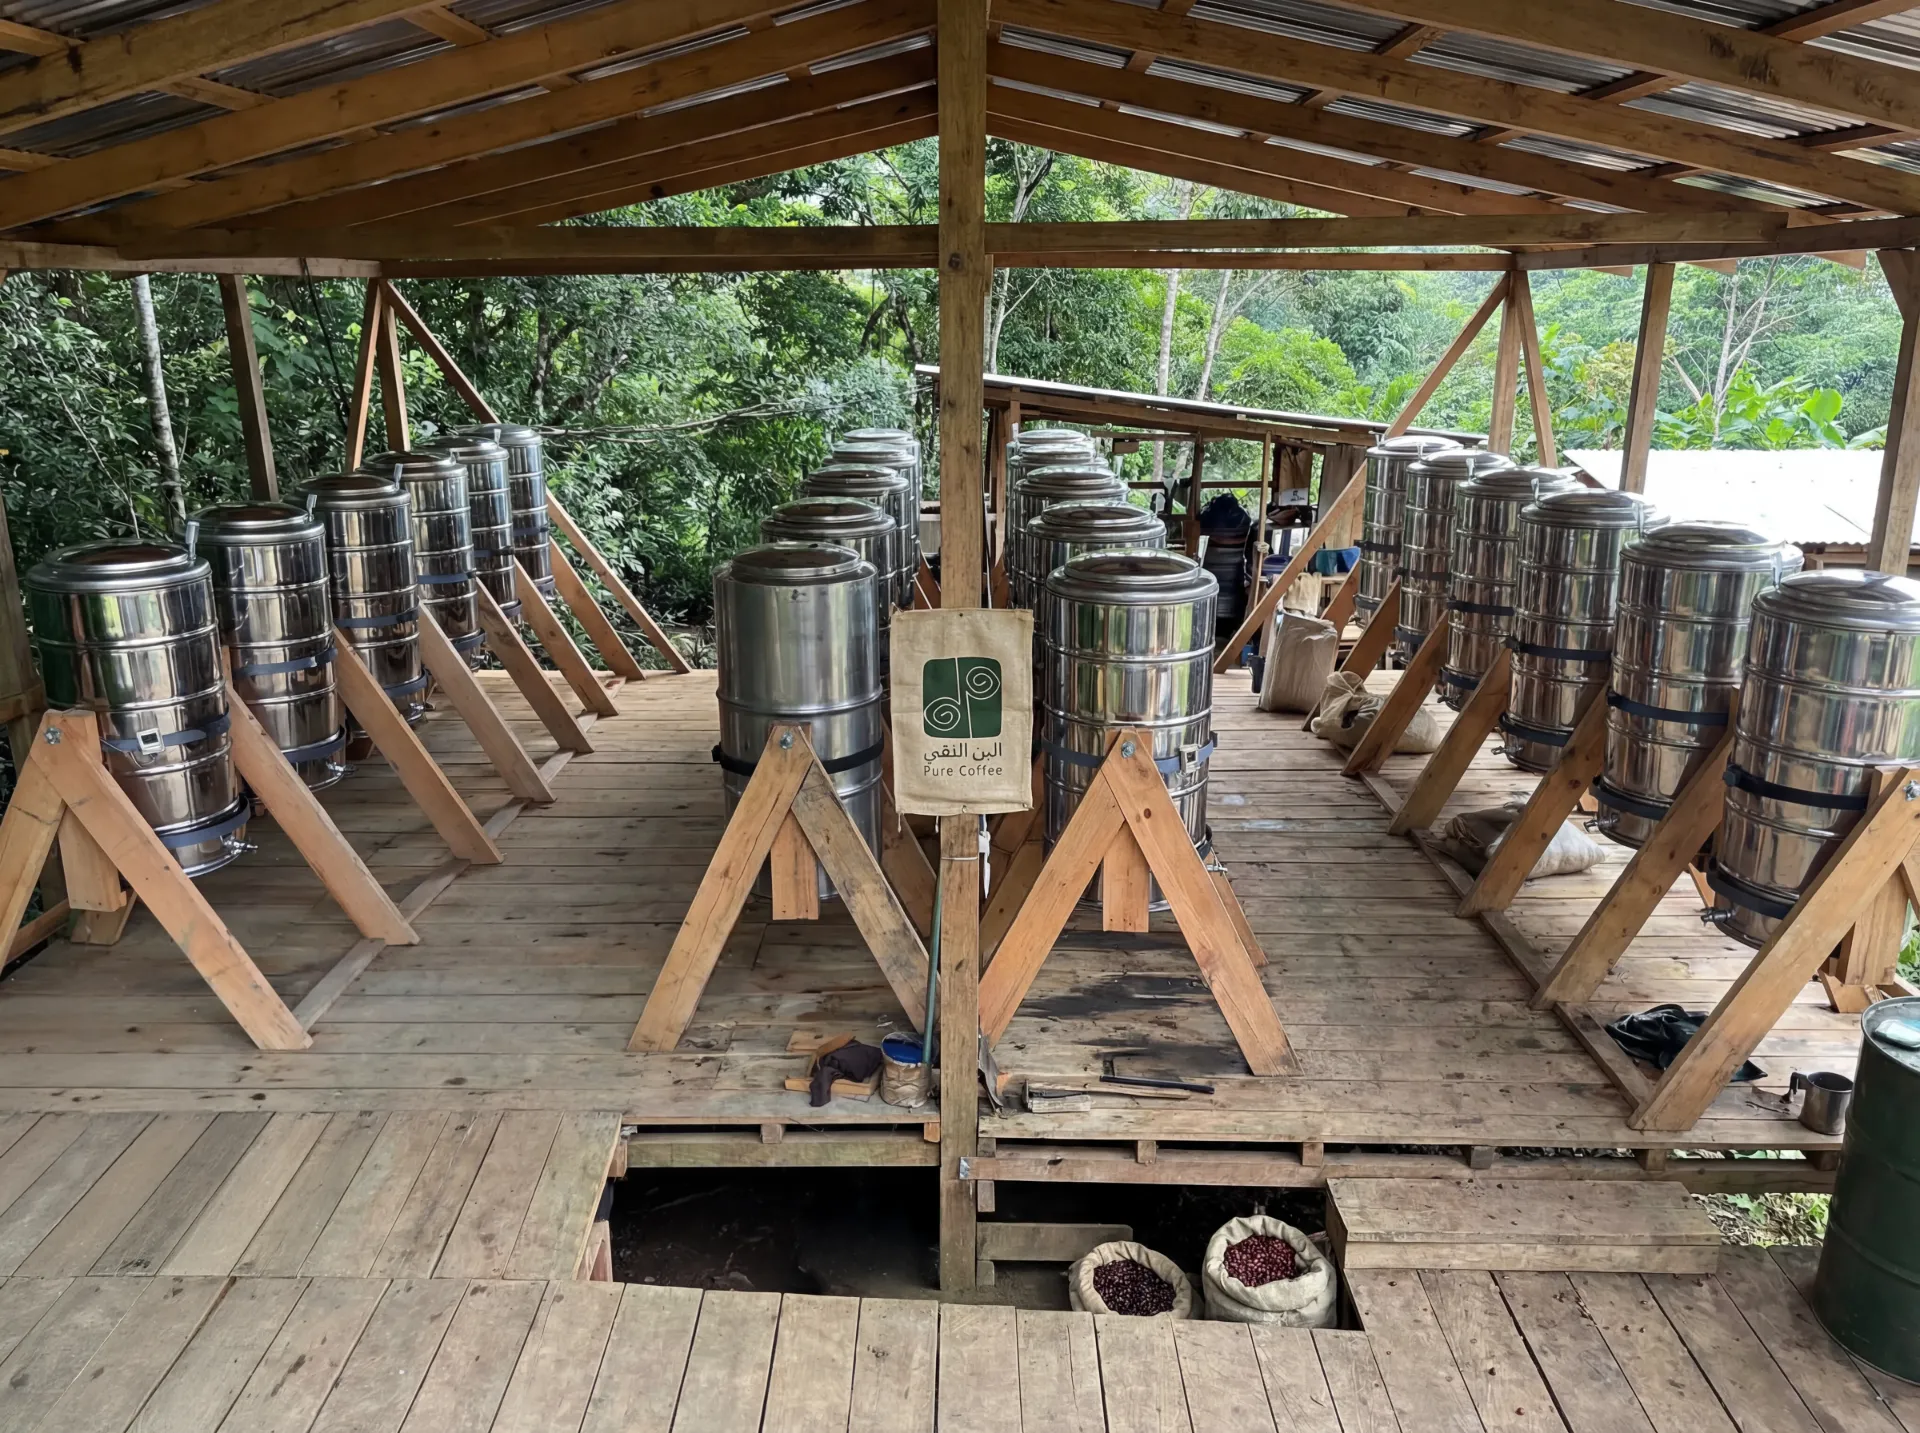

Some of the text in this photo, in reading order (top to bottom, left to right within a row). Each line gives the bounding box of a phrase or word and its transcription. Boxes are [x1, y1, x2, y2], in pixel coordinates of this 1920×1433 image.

[924, 742, 1002, 764] البن النقي
[923, 764, 1003, 777] Pure Coffee
